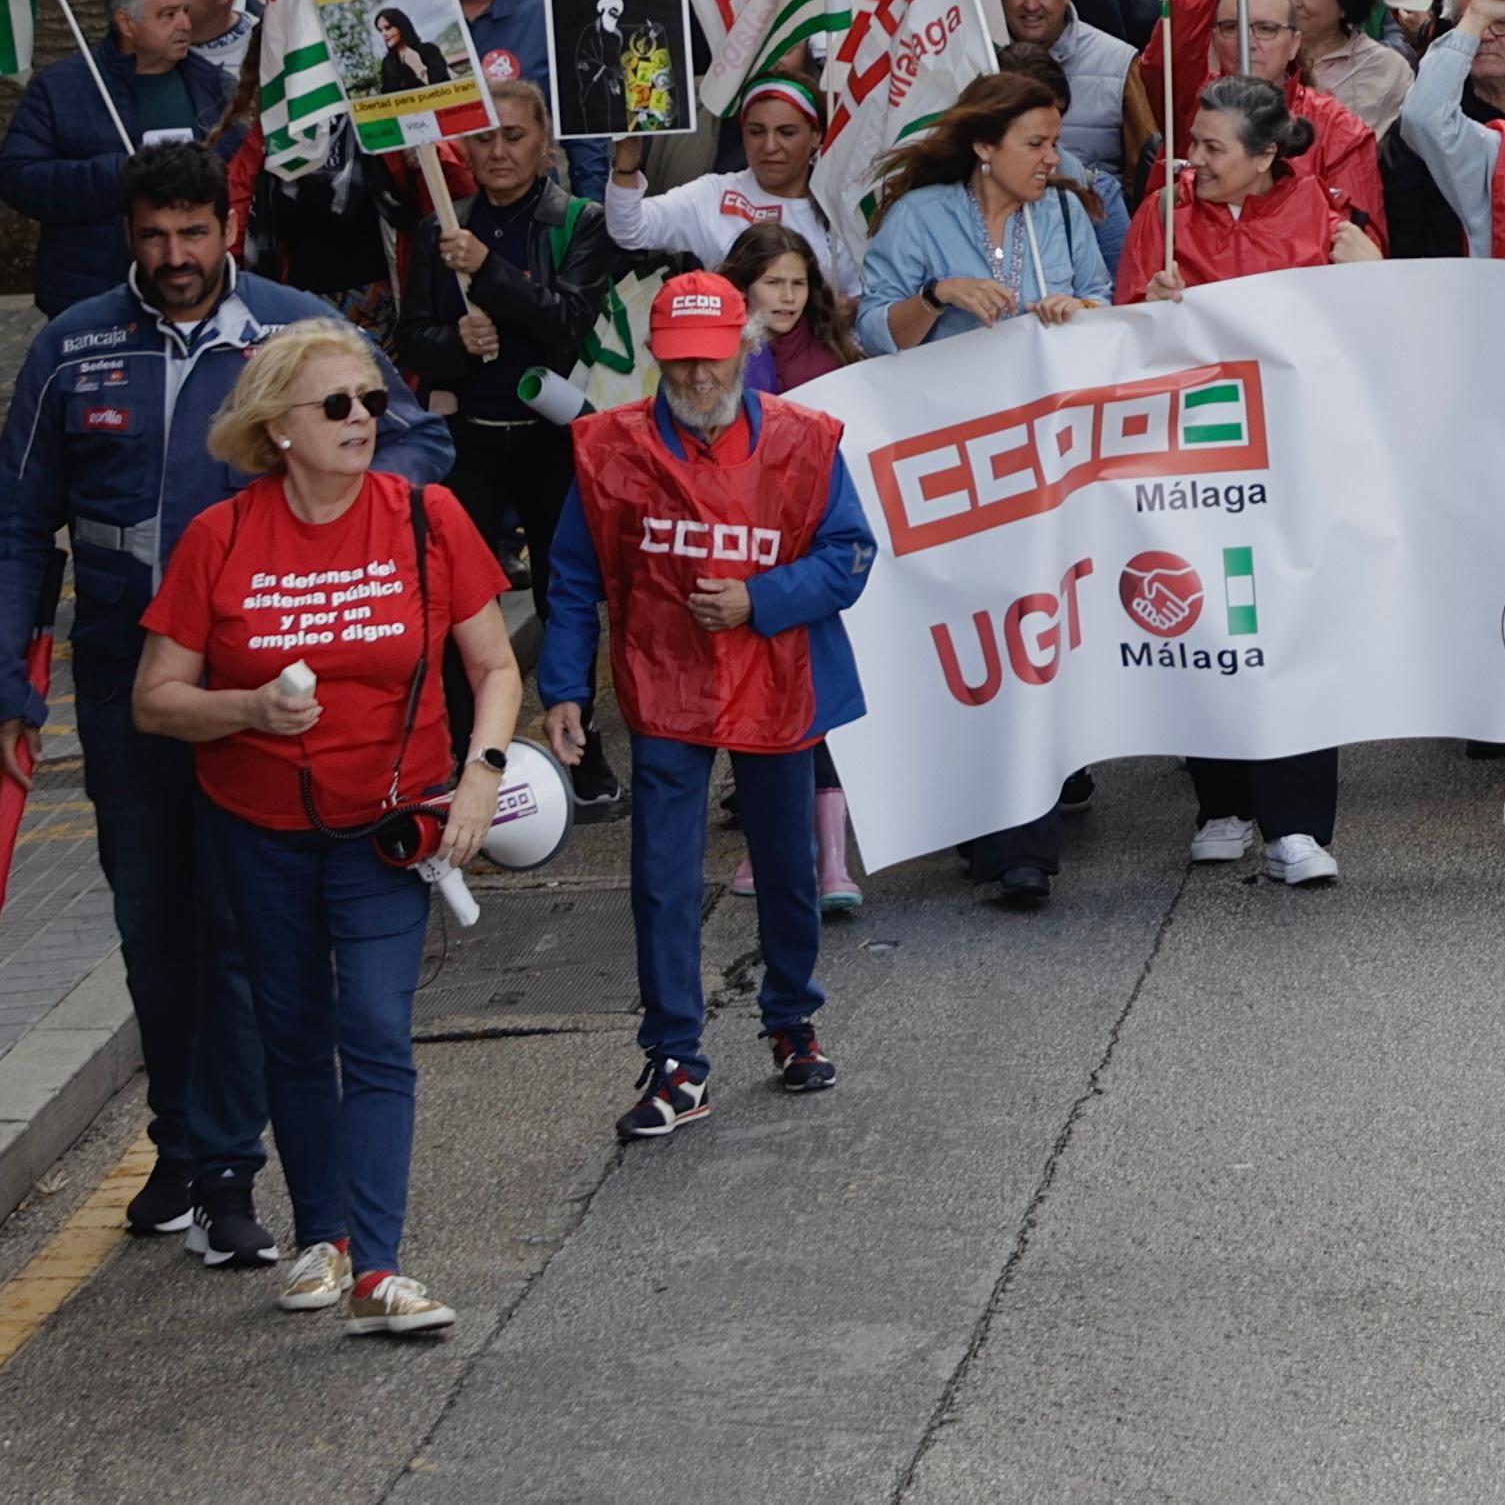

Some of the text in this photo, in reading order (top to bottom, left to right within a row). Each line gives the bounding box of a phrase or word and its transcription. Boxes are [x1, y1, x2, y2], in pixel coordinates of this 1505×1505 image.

[672, 295, 722, 309] CCOO
[62, 325, 128, 353] Bancaja
[890, 390, 1174, 529] CCOO
[1134, 480, 1269, 515] Málaga
[639, 516, 782, 566] CCOO
[252, 558, 397, 590] En defensa del
[242, 580, 404, 610] sistema público
[280, 605, 371, 631] y por un
[929, 555, 1095, 708] UGT
[248, 622, 406, 650] empleo digno
[1119, 641, 1266, 677] Málaga
